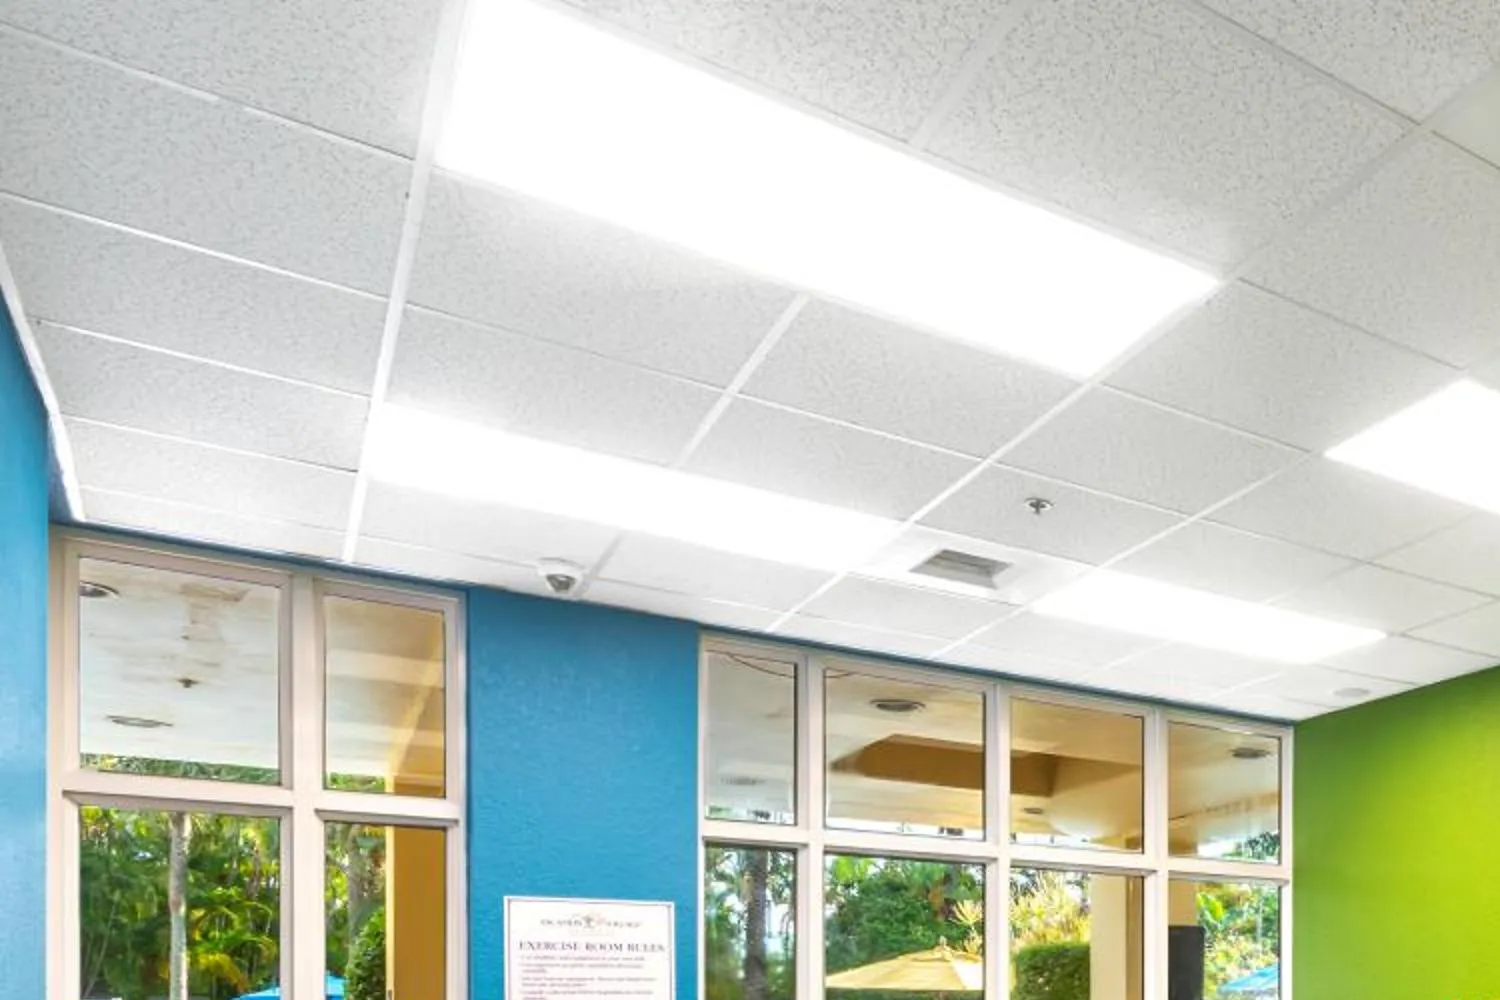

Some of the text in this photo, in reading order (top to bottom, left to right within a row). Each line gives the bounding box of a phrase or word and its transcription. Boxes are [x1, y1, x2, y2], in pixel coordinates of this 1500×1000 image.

[519, 940, 665, 953] EXERCISE ROOM RULES
